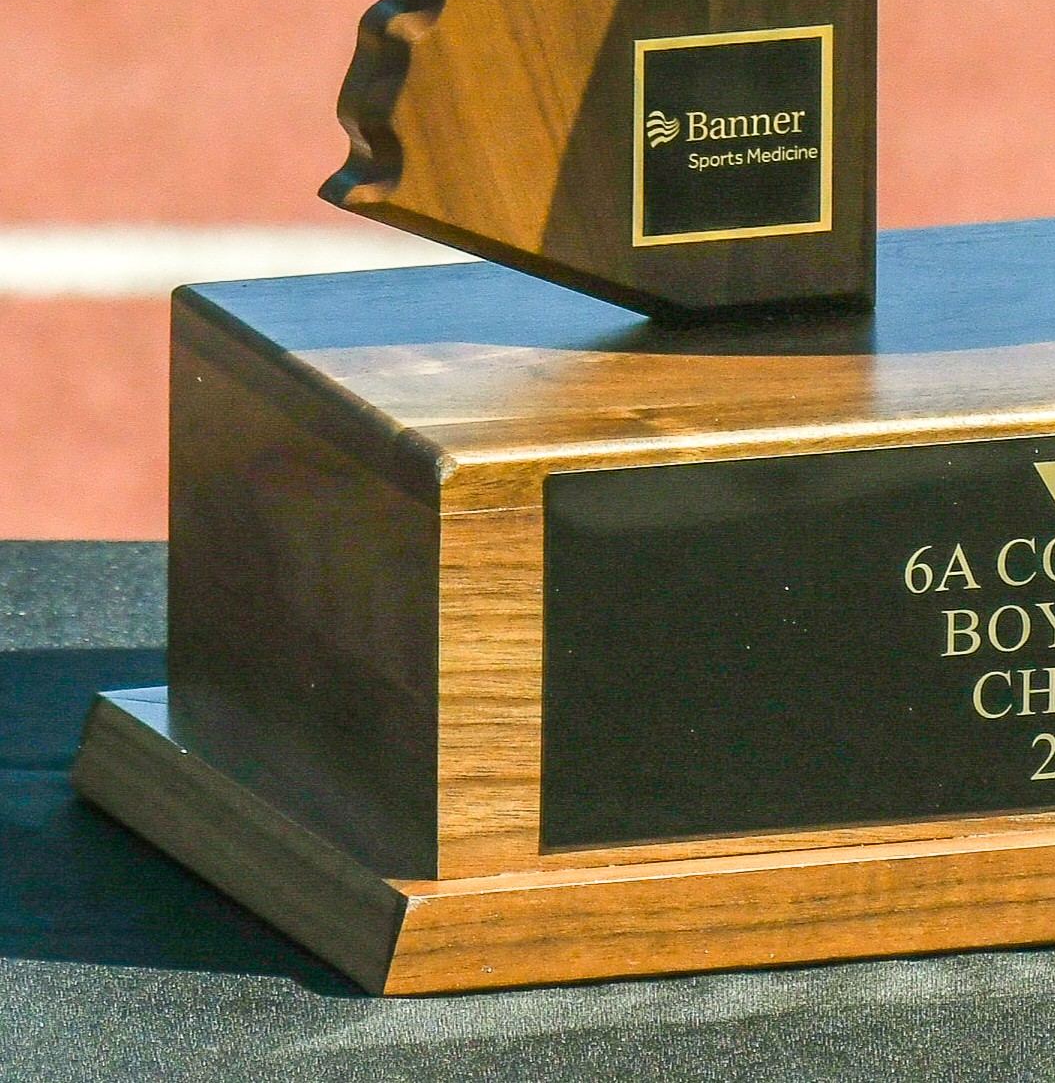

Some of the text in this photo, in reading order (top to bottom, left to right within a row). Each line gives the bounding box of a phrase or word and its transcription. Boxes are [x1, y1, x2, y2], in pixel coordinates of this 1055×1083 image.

[685, 110, 806, 142] Banner
[688, 145, 819, 172] Sports Medicine
[904, 542, 982, 594] 6A
